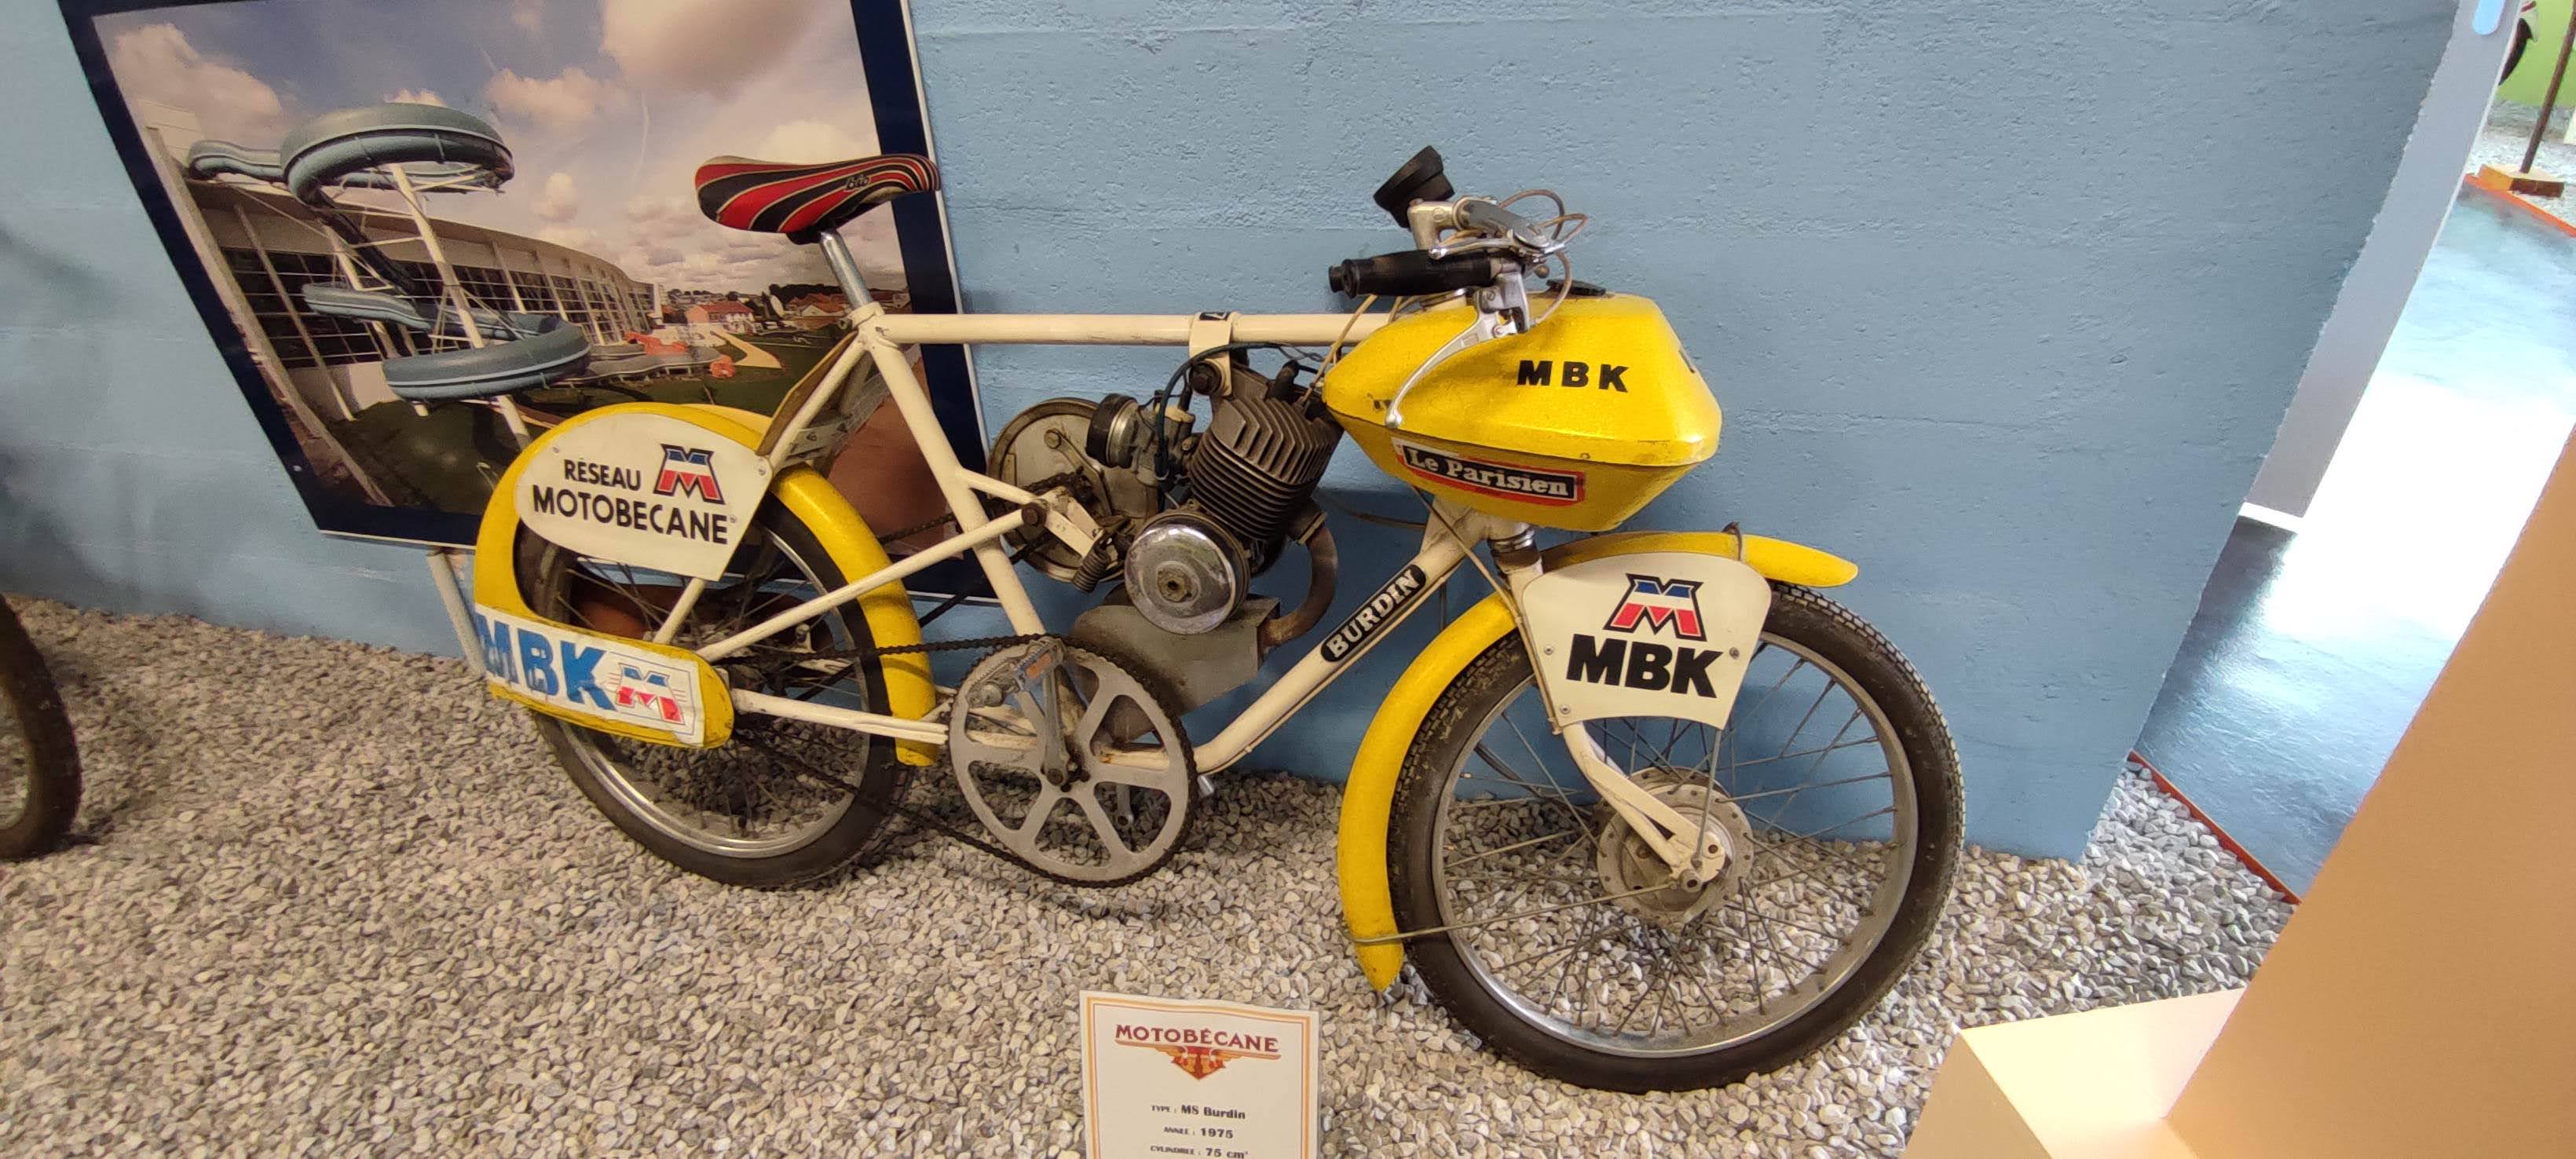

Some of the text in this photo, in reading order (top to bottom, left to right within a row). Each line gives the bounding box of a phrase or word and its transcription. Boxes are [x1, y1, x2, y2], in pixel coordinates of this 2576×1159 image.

[1517, 360, 1631, 393] MBK
[564, 457, 642, 492] RÉSEAU
[1408, 448, 1568, 496] Le Parisien
[532, 484, 728, 544] MOTOBECANE
[1326, 569, 1420, 658] BURDIN
[475, 612, 617, 711] MBK
[1566, 634, 1724, 699] MBK
[1115, 1023, 1279, 1053] MOTOBÉCANE
[1180, 1104, 1199, 1115] MS
[1203, 1106, 1246, 1120] Burdin
[1200, 1127, 1234, 1139] 1975
[1206, 1147, 1222, 1157] 75
